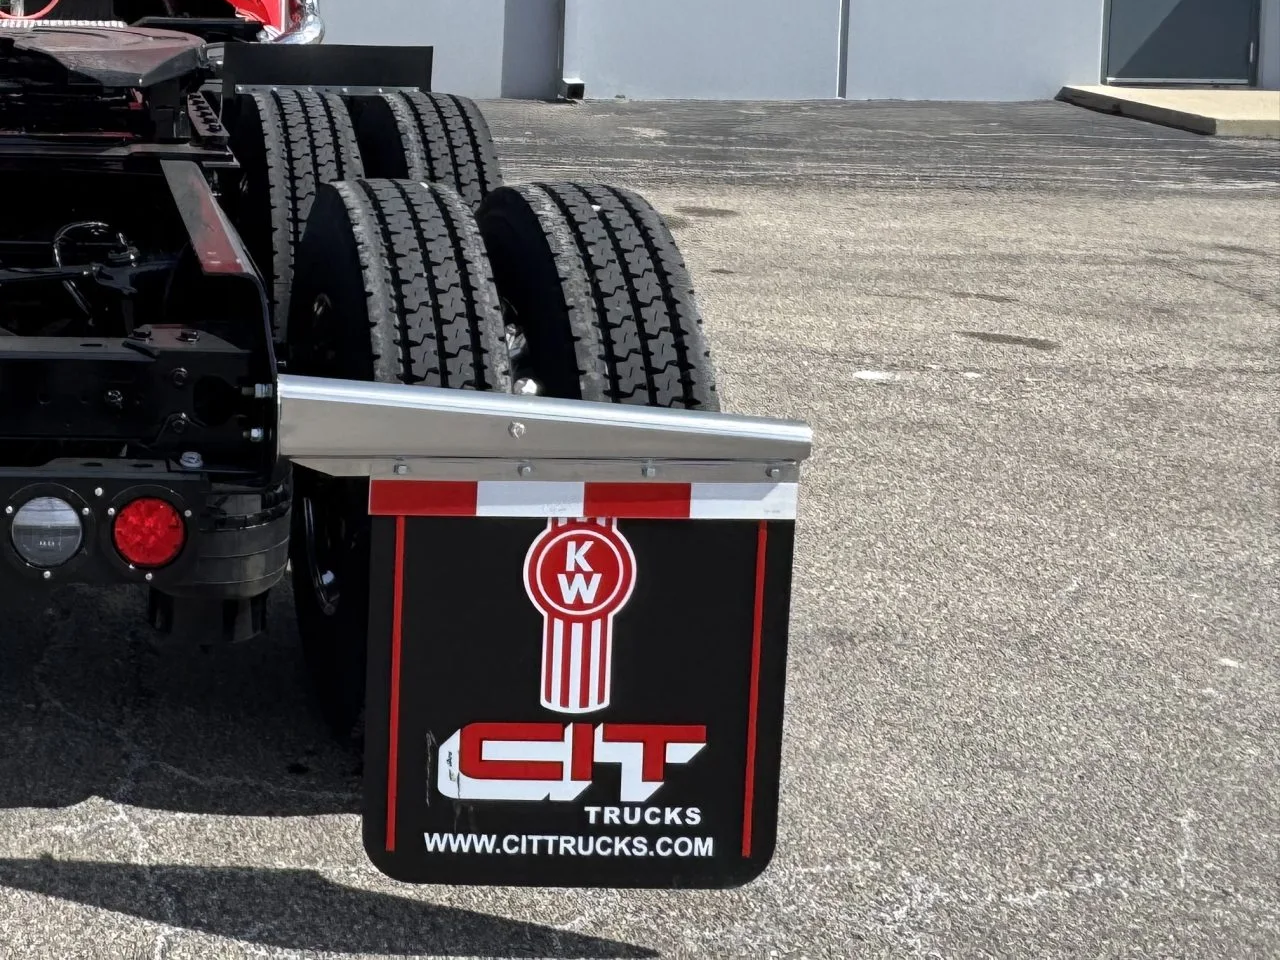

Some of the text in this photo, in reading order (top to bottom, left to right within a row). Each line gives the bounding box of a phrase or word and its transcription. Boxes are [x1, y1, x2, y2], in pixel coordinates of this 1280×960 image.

[437, 722, 707, 802] CIT
[584, 806, 702, 825] TRUCKS
[423, 832, 714, 857] WWW.CITTRUCKS.COM
